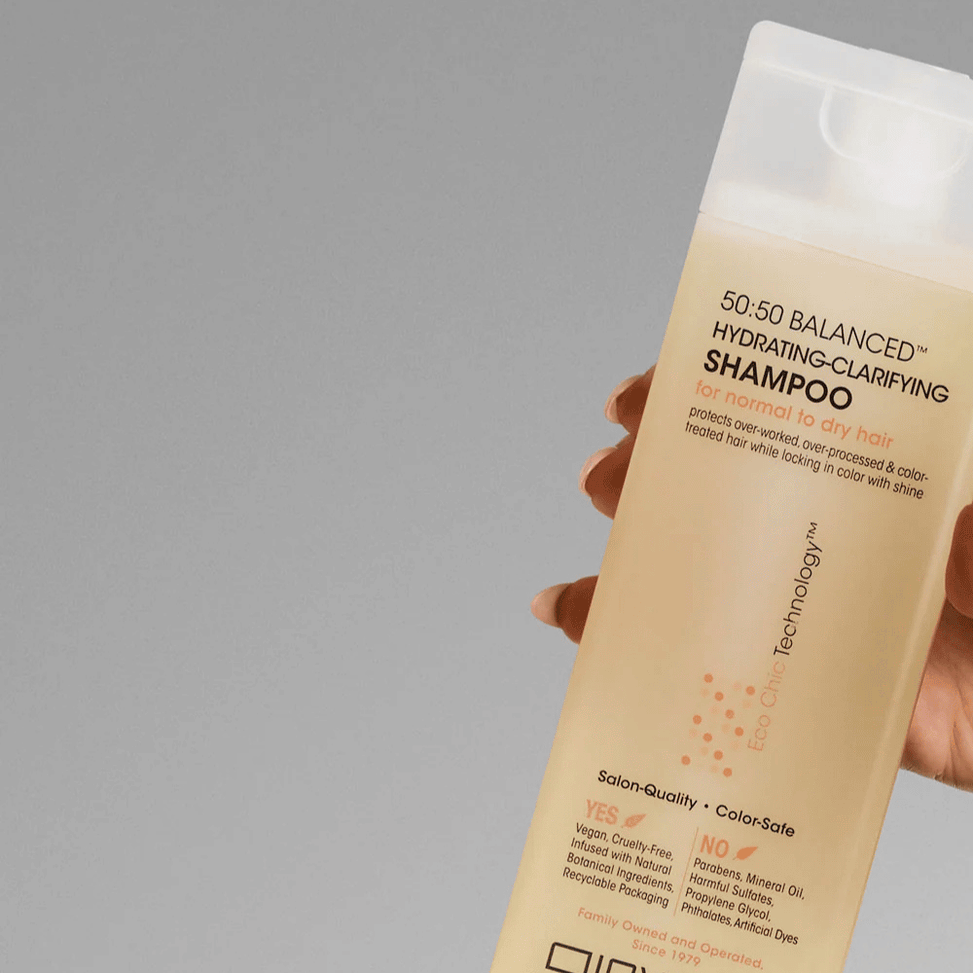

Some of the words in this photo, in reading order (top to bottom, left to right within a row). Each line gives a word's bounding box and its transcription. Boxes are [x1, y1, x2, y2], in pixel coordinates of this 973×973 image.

[720, 290, 784, 325] 50:50
[703, 349, 853, 411] SHAMPOO
[712, 320, 950, 403] HYDRATING-CLARIFYING
[695, 379, 721, 400] for
[725, 391, 793, 421] normal
[797, 408, 815, 427] to
[821, 417, 852, 440] dry
[856, 425, 894, 449] hair
[685, 420, 725, 442] treated
[725, 432, 748, 449] hair
[750, 441, 779, 459] while
[781, 448, 821, 473] locking
[823, 460, 834, 474] in
[837, 467, 866, 483] color
[868, 475, 891, 490] with
[892, 481, 924, 500] shine
[688, 407, 733, 428] protects
[734, 420, 800, 448] over-worked,
[802, 440, 885, 471] over-processed
[885, 461, 896, 474] &
[897, 466, 929, 482] color-
[747, 714, 771, 751] Eco
[760, 661, 785, 708] Chic
[586, 799, 619, 825] YES
[597, 769, 698, 811] Salon-Quality
[715, 804, 795, 838] Color-Safe
[570, 837, 609, 857] Infused
[611, 850, 632, 864] with
[634, 855, 672, 876] Natural
[576, 822, 609, 843] Vegan,
[611, 833, 674, 862] Cruelty-Free,
[699, 834, 730, 859] NO
[562, 866, 617, 892] Recyclable
[618, 882, 669, 909] Packaging
[566, 851, 615, 875] Botanical
[616, 866, 674, 893] Ingredients,
[689, 872, 730, 893] Harmful
[731, 884, 774, 907] Sulfates,
[693, 857, 743, 882] Parabens,
[745, 872, 786, 893] Mineral
[788, 885, 805, 900] Oil,
[685, 886, 735, 911] Propylene
[737, 902, 771, 923] Glycol,
[578, 907, 619, 929] Family
[622, 920, 668, 941] Owned
[670, 936, 697, 950] and
[774, 928, 799, 945] Dyes
[632, 939, 666, 957] Since
[672, 949, 701, 967] 1979
